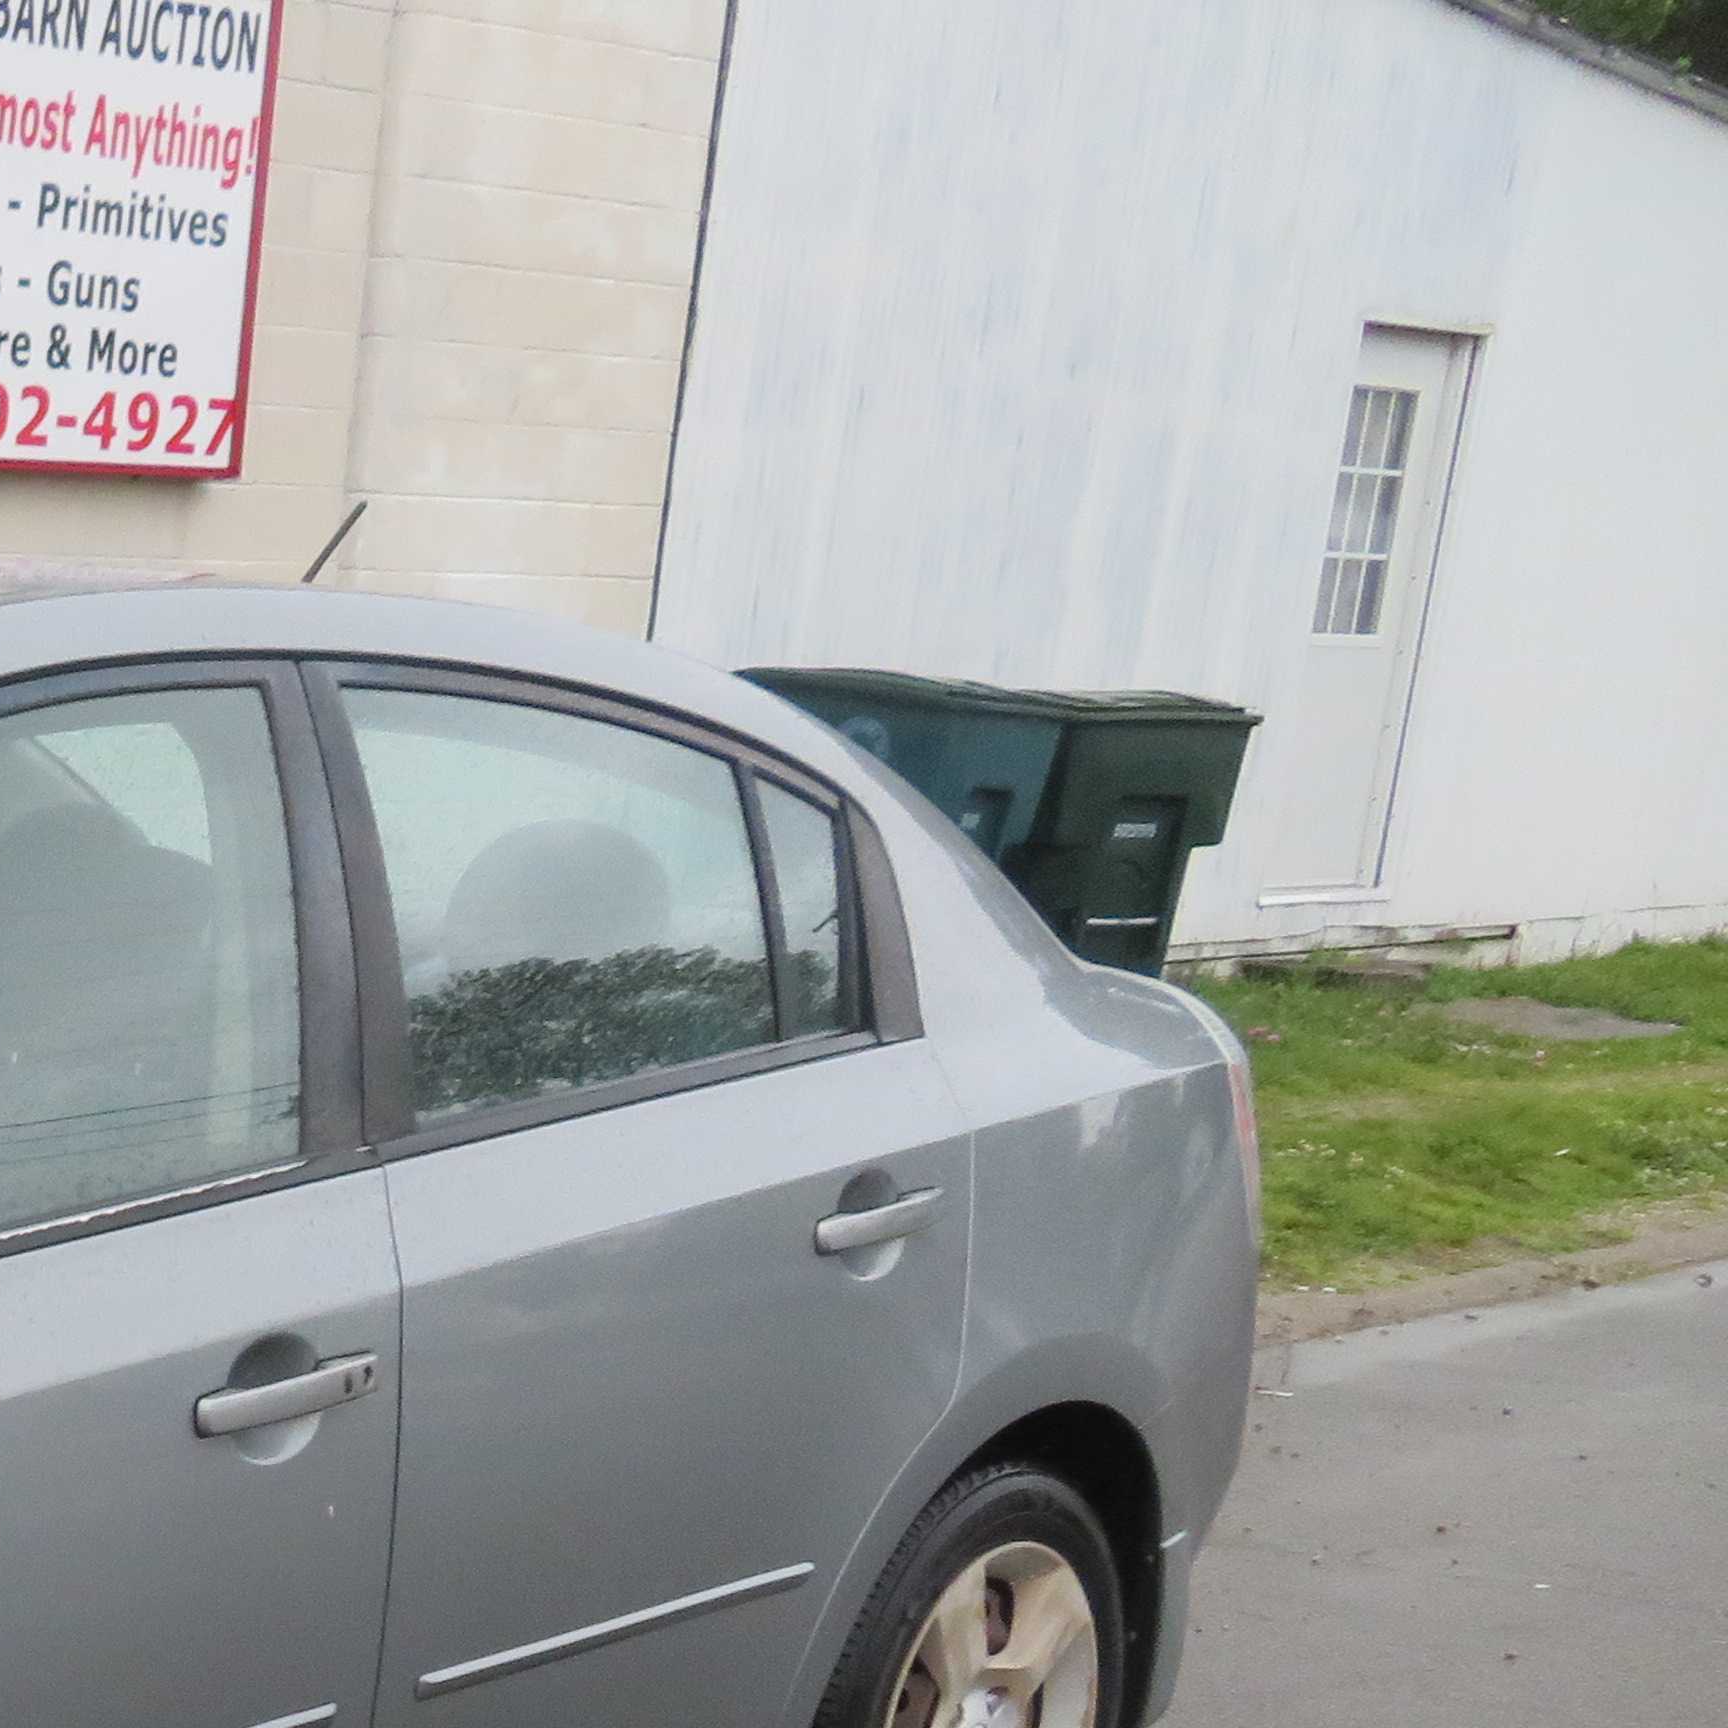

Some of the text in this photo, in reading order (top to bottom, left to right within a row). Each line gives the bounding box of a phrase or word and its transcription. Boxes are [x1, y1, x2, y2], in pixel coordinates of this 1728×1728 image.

[100, 0, 262, 74] AUCTION
[85, 94, 260, 190] Anything!
[36, 182, 229, 247] Primitives
[47, 261, 140, 312] Guns
[46, 325, 71, 370] &
[87, 329, 178, 378] More
